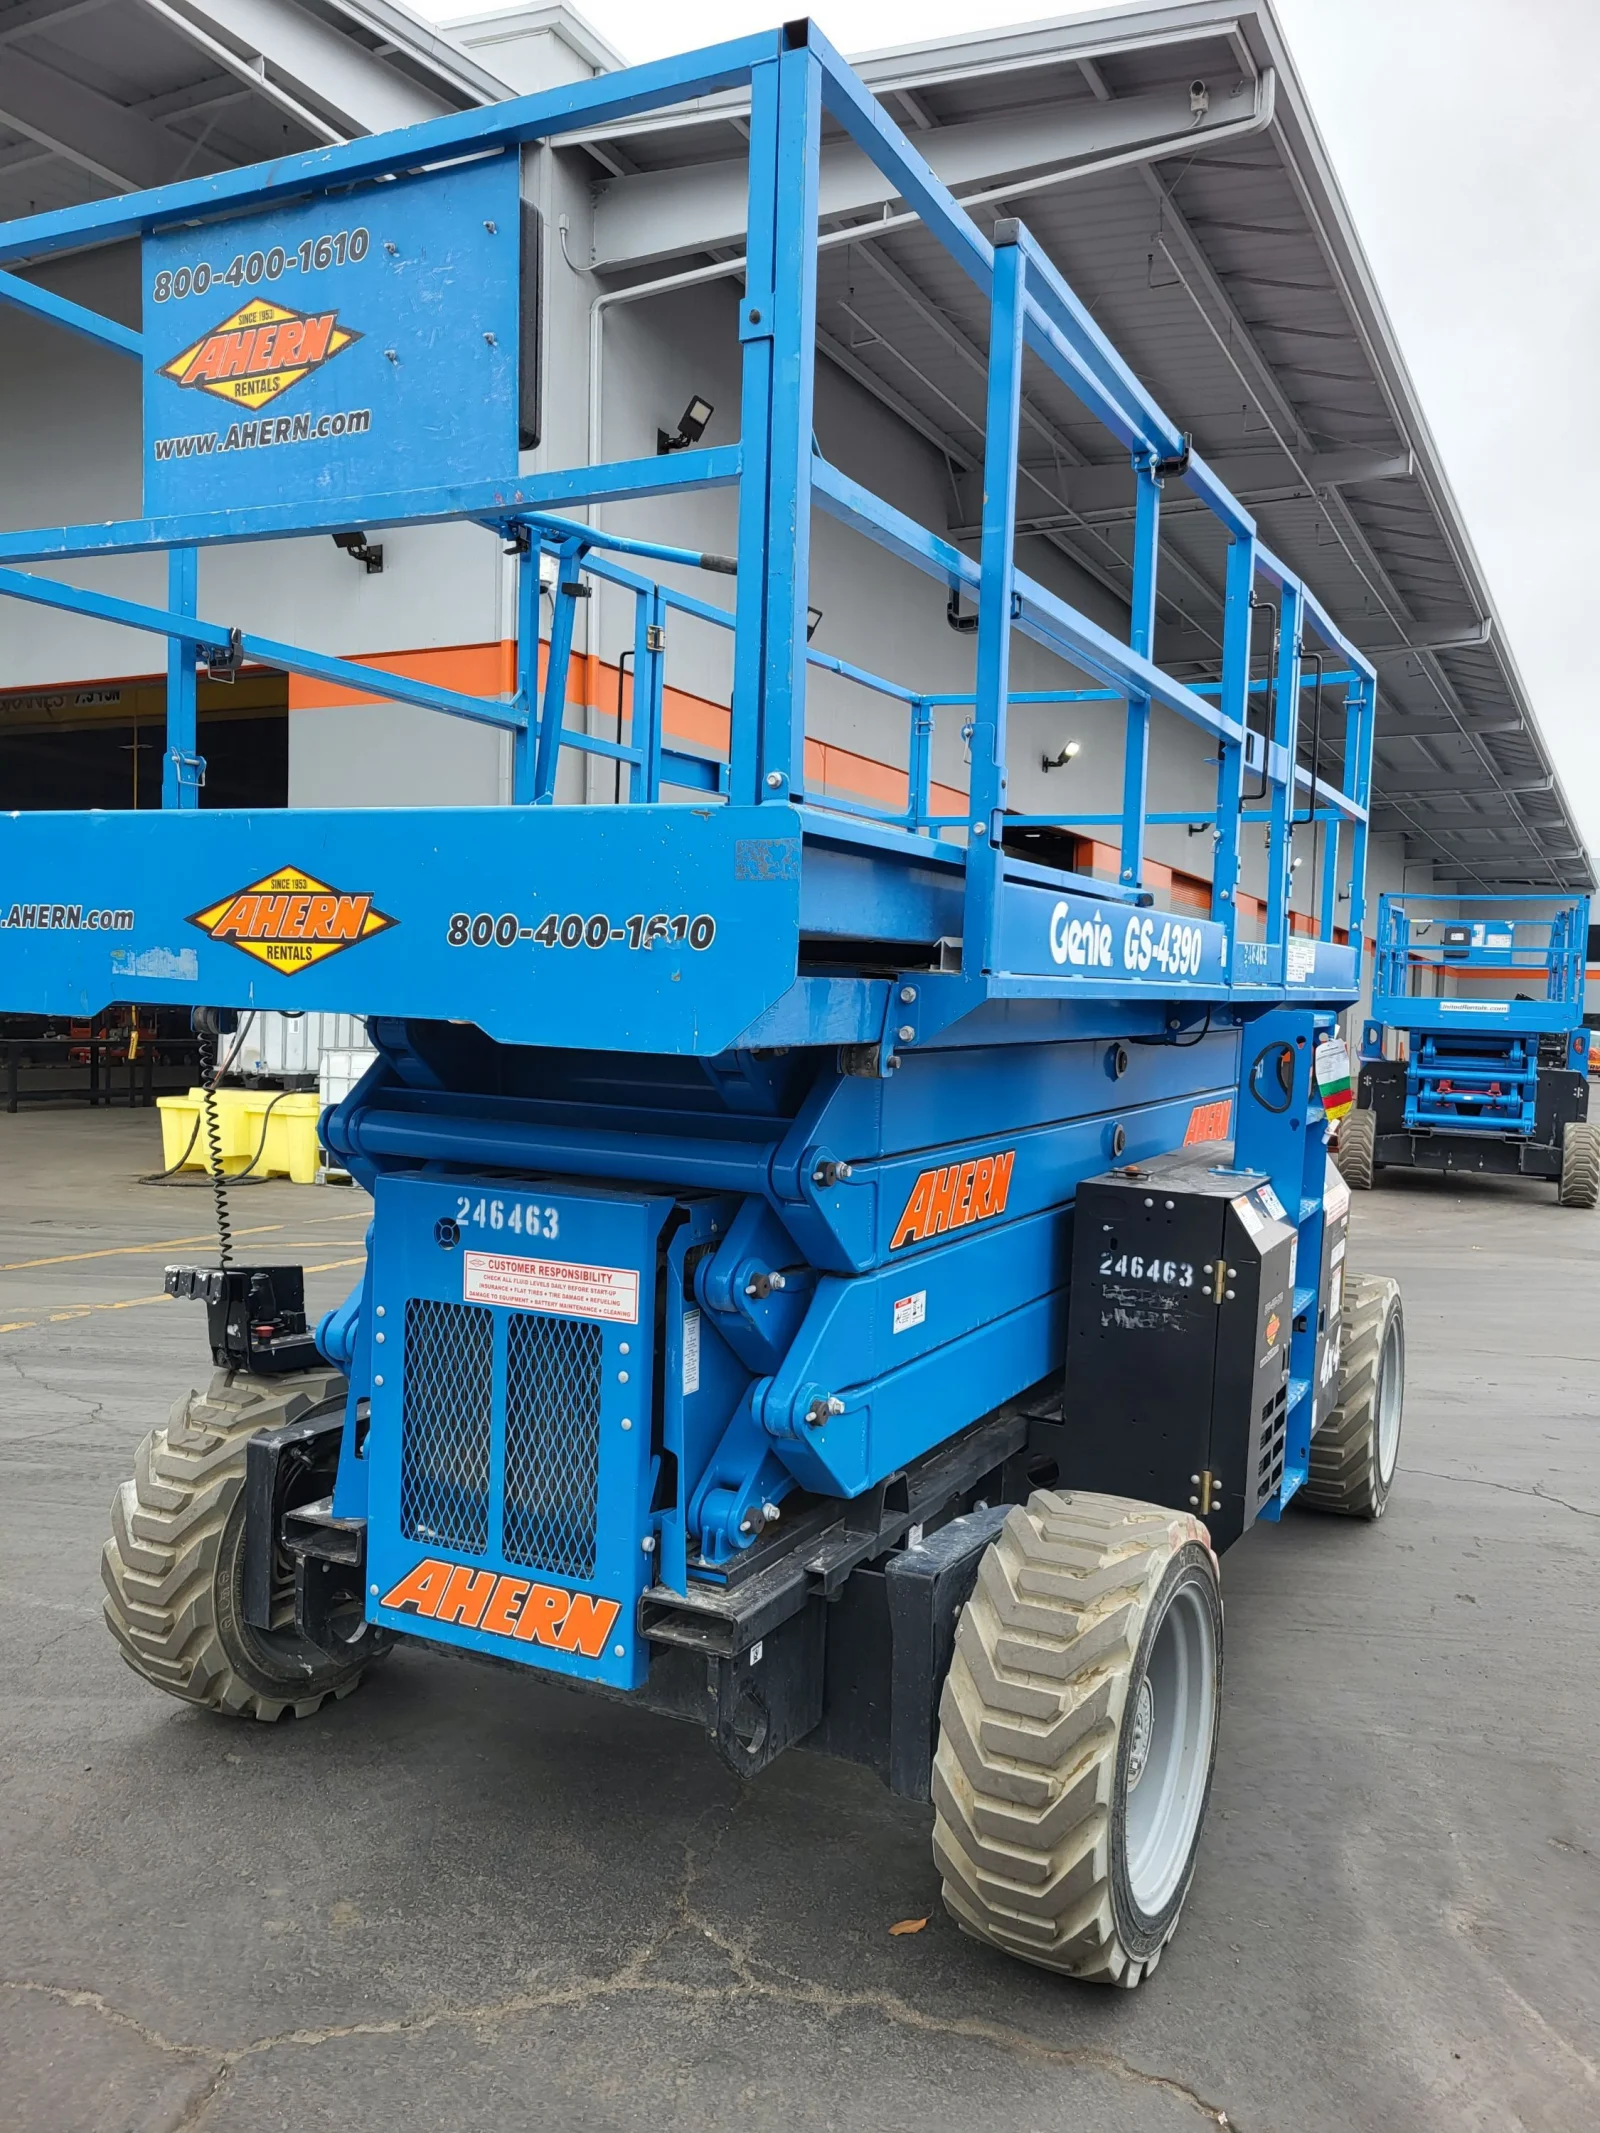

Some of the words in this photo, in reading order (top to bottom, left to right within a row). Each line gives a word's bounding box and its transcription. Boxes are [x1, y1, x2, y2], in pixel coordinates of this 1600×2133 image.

[152, 227, 371, 303] 800-400-1610
[238, 312, 257, 325] SINCE
[259, 309, 274, 322] 1953
[181, 314, 335, 384] AHERN
[234, 376, 281, 398] RENTALS
[153, 408, 371, 462] www.AHERN.com
[271, 879, 290, 890] SINCE
[292, 879, 307, 890] 1953
[0, 904, 134, 930] .AHERN.com
[211, 895, 370, 939] AHERN
[266, 945, 313, 961] RENTALS
[1050, 900, 1113, 968] Genie
[1123, 916, 1201, 976] GS-4390
[1183, 1099, 1232, 1147] AHERN
[456, 1196, 559, 1239] 246463
[890, 1150, 1015, 1250] AHERN
[483, 1274, 501, 1282] CHECK
[502, 1276, 513, 1284] ALL
[513, 1278, 529, 1286] FLUID
[530, 1280, 550, 1288] LEVELS
[551, 1282, 567, 1291] DAILY
[568, 1285, 589, 1293] BEFORE
[590, 1287, 617, 1296] START-UP
[488, 1259, 536, 1275] CUSTOMER
[538, 1265, 613, 1284] RESPONSIBILITY
[1100, 1252, 1193, 1287] 246463
[469, 1290, 490, 1299] DAMAGE
[499, 1294, 529, 1304] EQUIPMENT
[534, 1299, 558, 1308] BATTERY
[559, 1302, 598, 1313] MAINTENANCE
[603, 1308, 631, 1318] CLEANING
[479, 1283, 509, 1292] INSURANCE
[528, 1289, 543, 1297] TIRES
[561, 1293, 584, 1302] DAMAGE
[590, 1297, 621, 1307] REFUELING
[380, 1558, 622, 1658] AHERN
